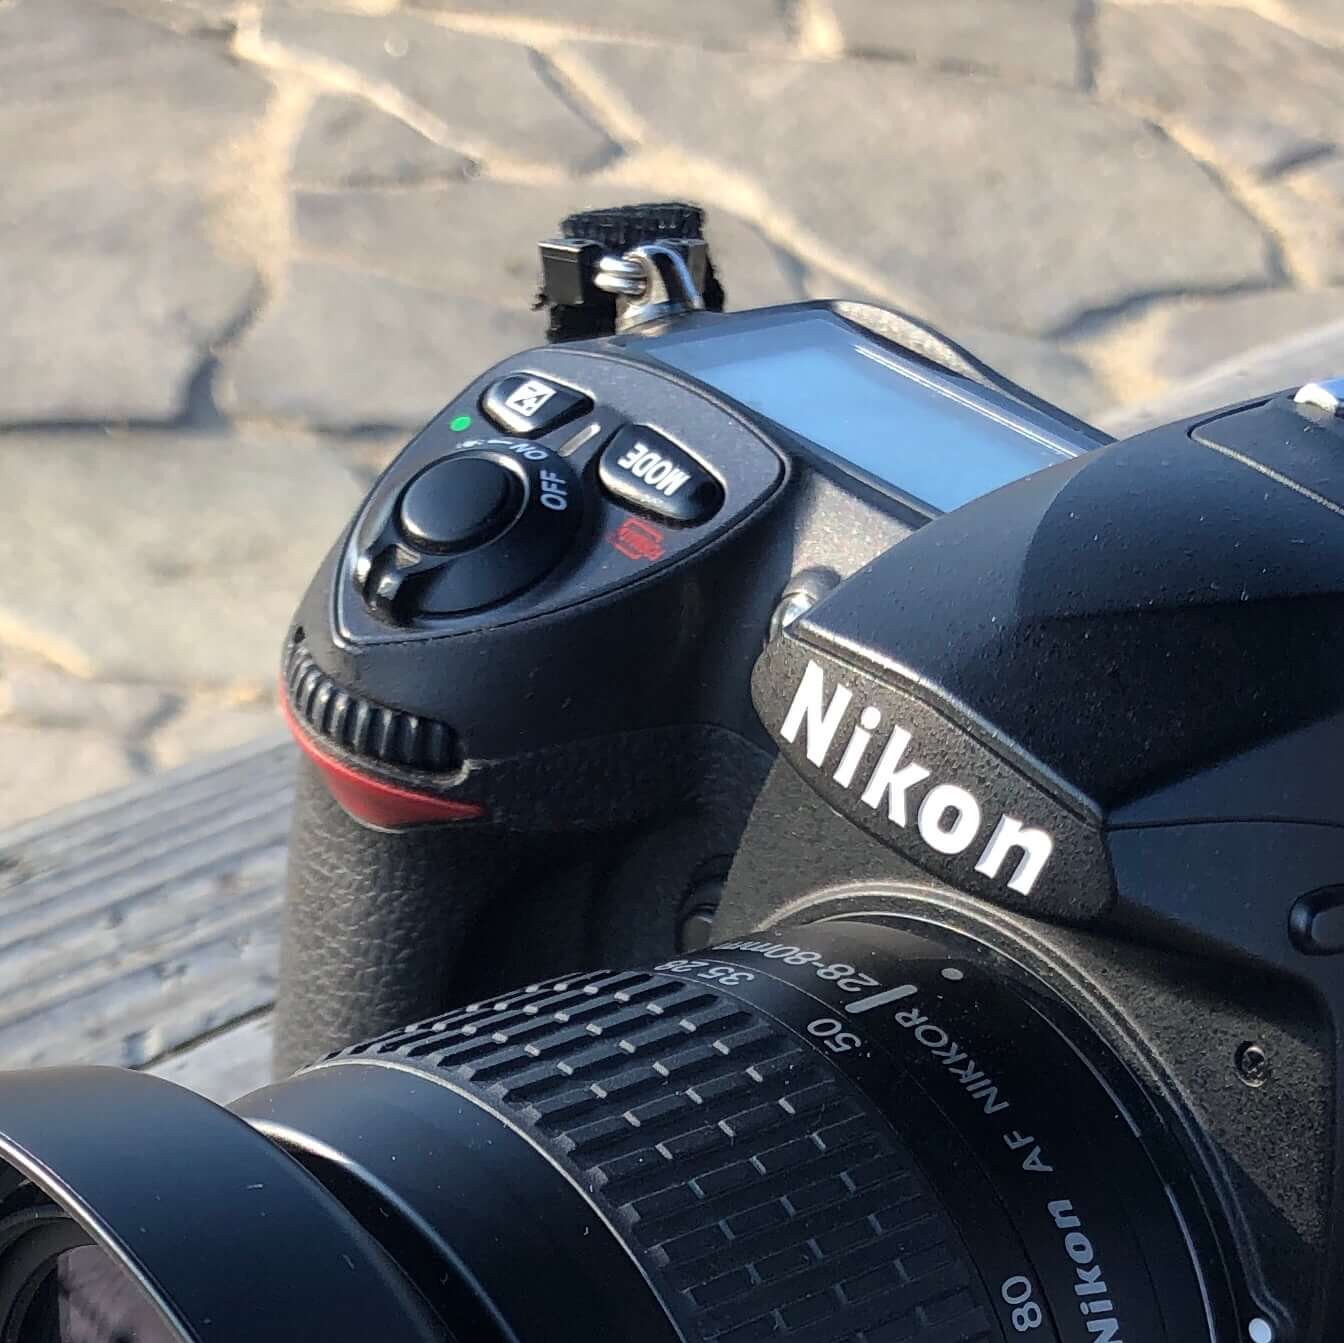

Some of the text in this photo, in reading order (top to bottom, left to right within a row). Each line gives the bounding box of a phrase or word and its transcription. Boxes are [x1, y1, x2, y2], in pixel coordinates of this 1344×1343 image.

[509, 443, 550, 461] ON
[617, 442, 691, 496] MODE
[540, 470, 567, 511] OFF
[780, 659, 1053, 896] Nikon
[697, 966, 755, 986] 35
[807, 1018, 862, 1053] 50
[894, 1008, 1009, 1114] NIKKOR
[1003, 1130, 1054, 1172] AF
[1001, 1275, 1042, 1332] 80
